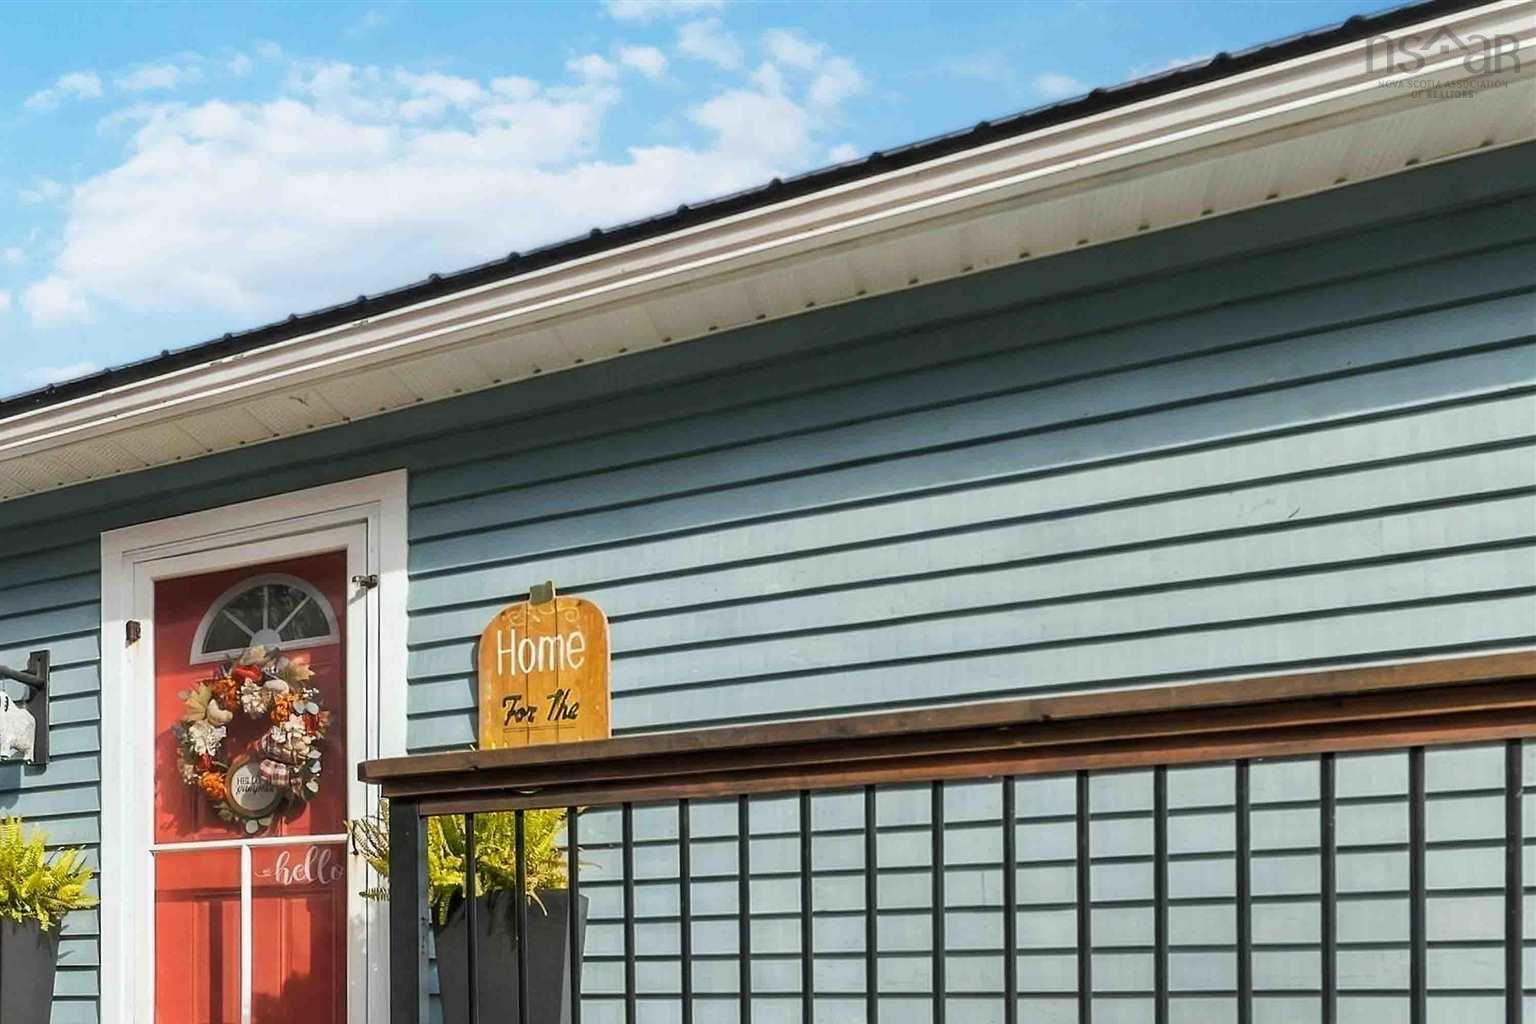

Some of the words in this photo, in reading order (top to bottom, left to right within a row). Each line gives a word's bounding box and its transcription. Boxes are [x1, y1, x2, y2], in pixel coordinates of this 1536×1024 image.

[497, 628, 586, 676] Home
[502, 694, 538, 727] For
[547, 688, 580, 721] The
[256, 846, 345, 886] hello
